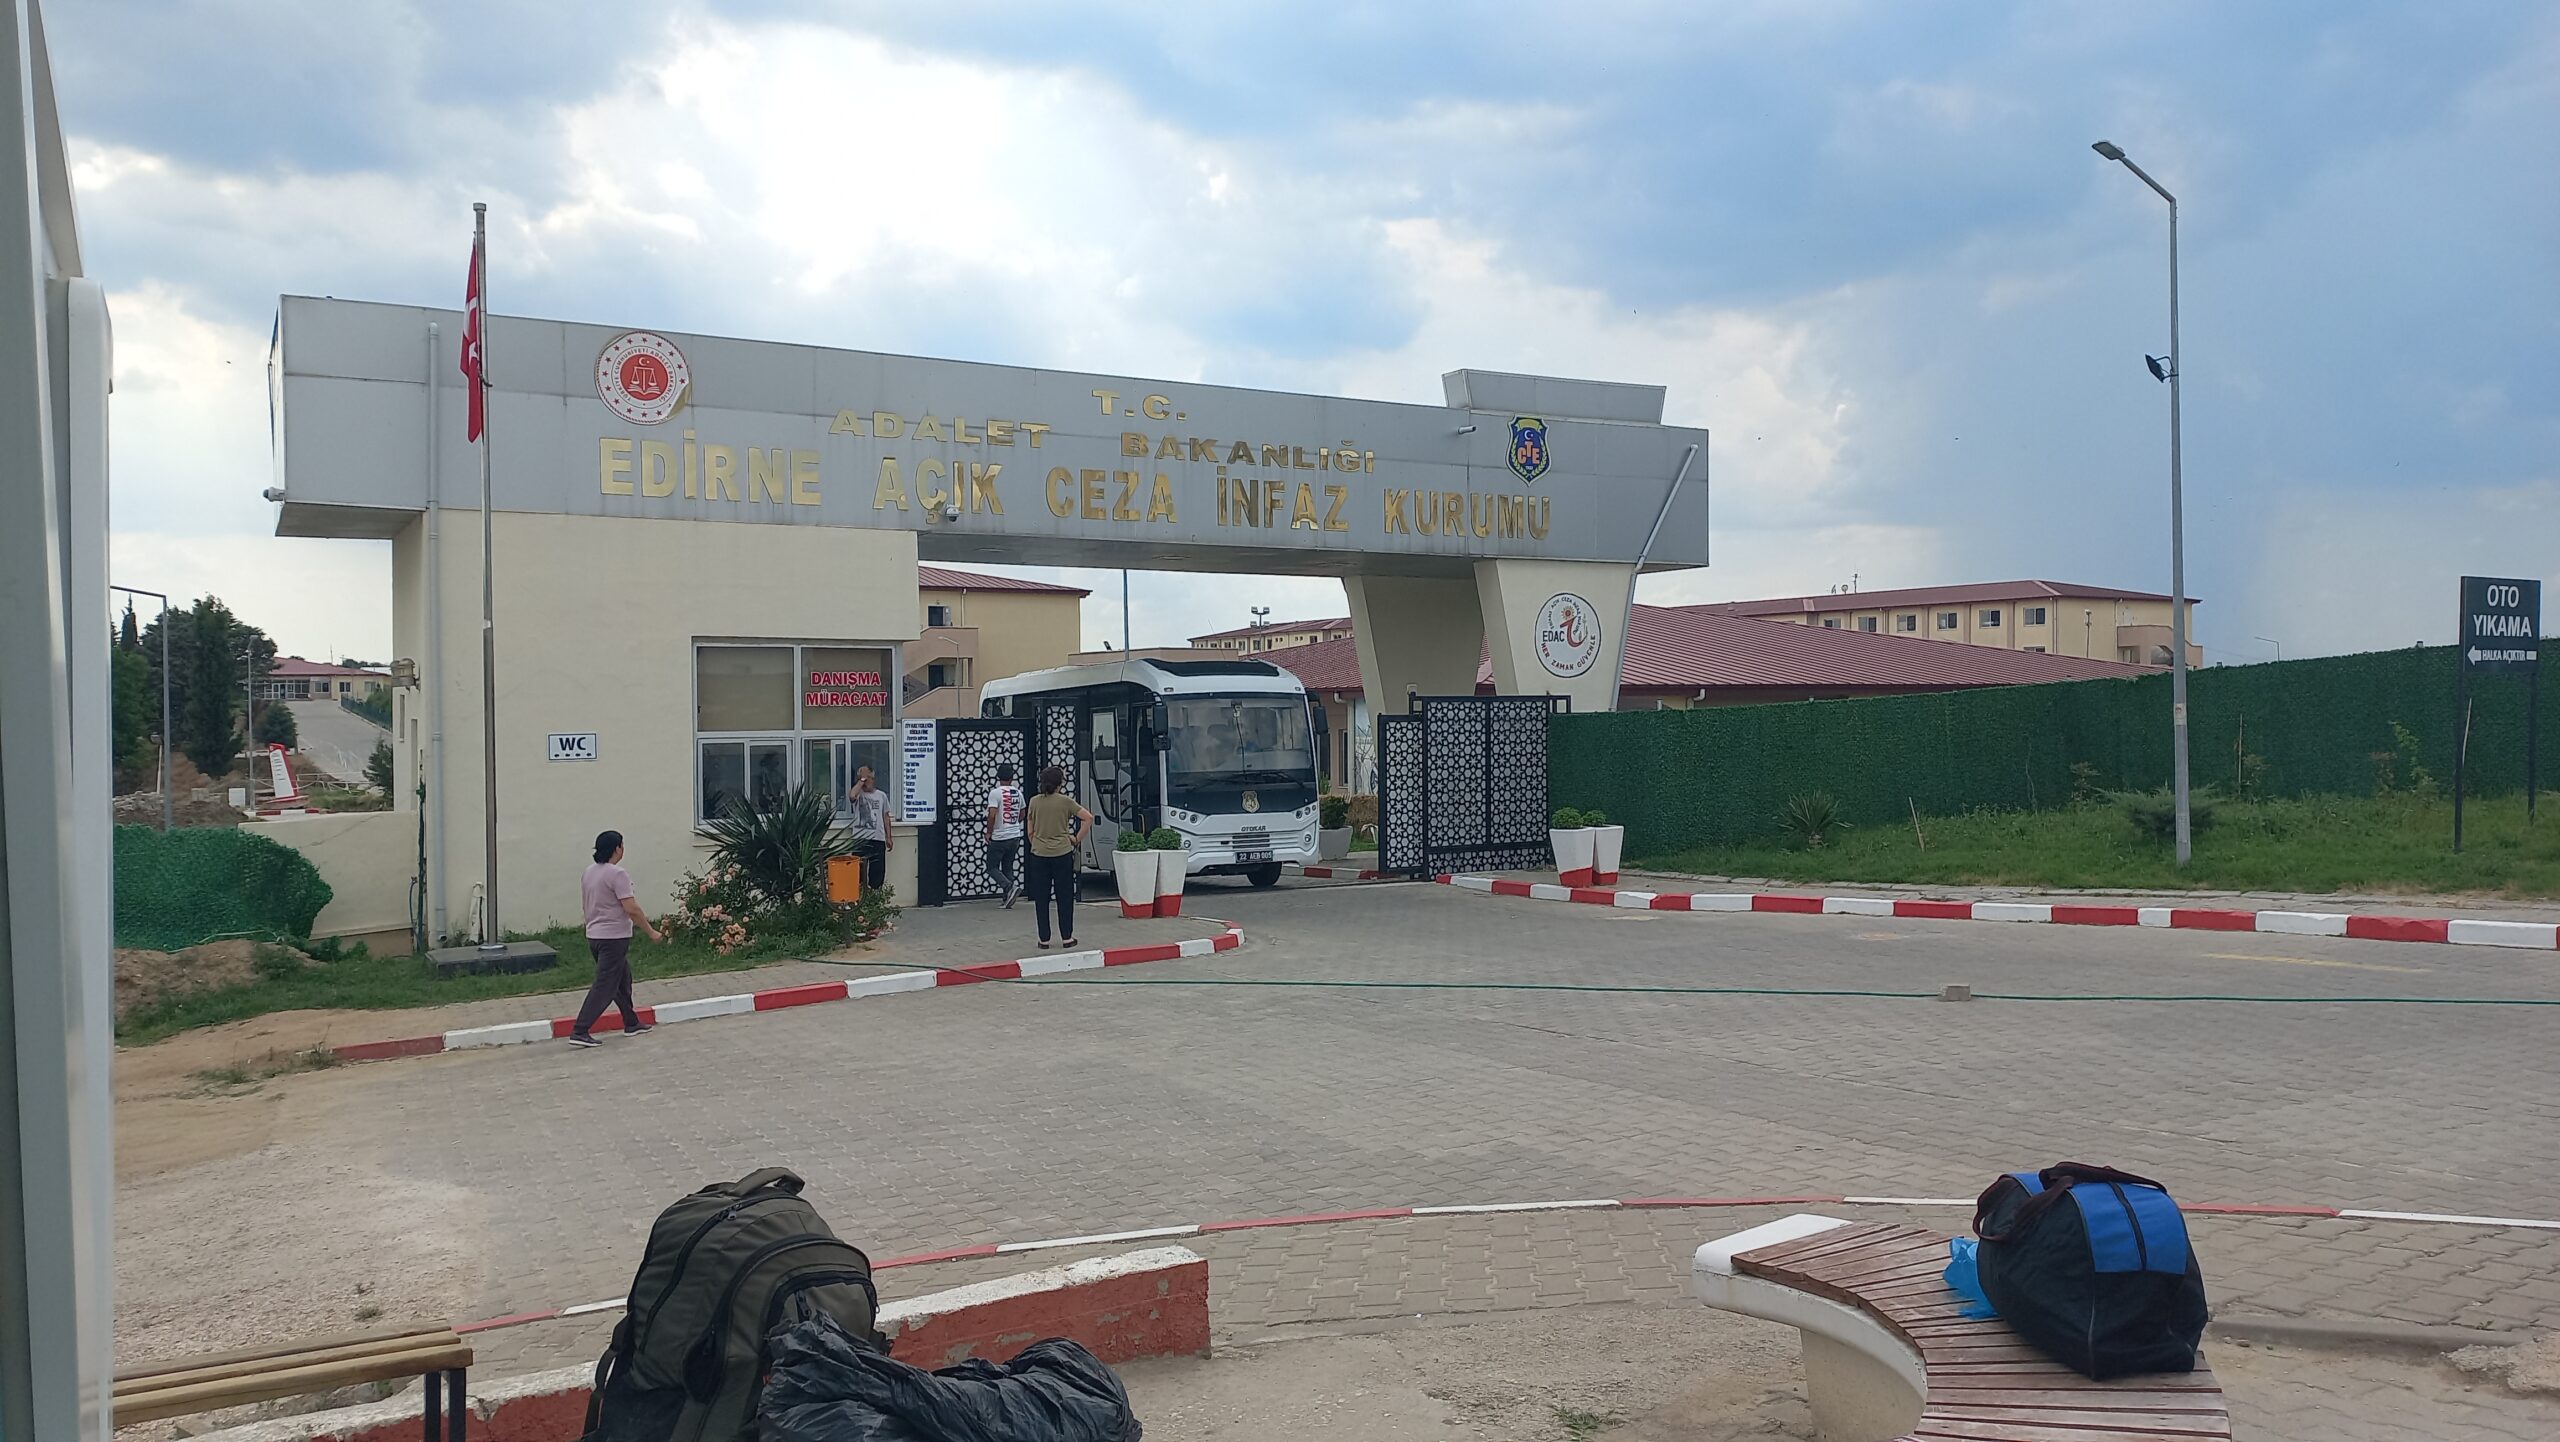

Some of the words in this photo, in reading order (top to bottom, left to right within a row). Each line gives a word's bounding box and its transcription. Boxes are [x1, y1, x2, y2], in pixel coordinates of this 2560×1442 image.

[1092, 390, 1187, 421] T.C.
[828, 410, 1050, 448] ADALET
[1121, 432, 1375, 473] BAKANLIĞI
[1517, 441, 1540, 465] CTE
[599, 429, 822, 506] EDİRNE
[872, 457, 1005, 524] AÇIK
[1046, 466, 1178, 523] CEZA
[1216, 465, 1350, 532] İNFAZ
[1384, 488, 1549, 540] KURUMU
[2487, 585, 2520, 608] OTO
[2473, 614, 2533, 637] YIKAMA
[811, 672, 881, 689] DANIŞMA
[805, 689, 887, 707] MÜRACAAT
[559, 736, 586, 751] WC
[1001, 788, 1011, 825] TOMMY
